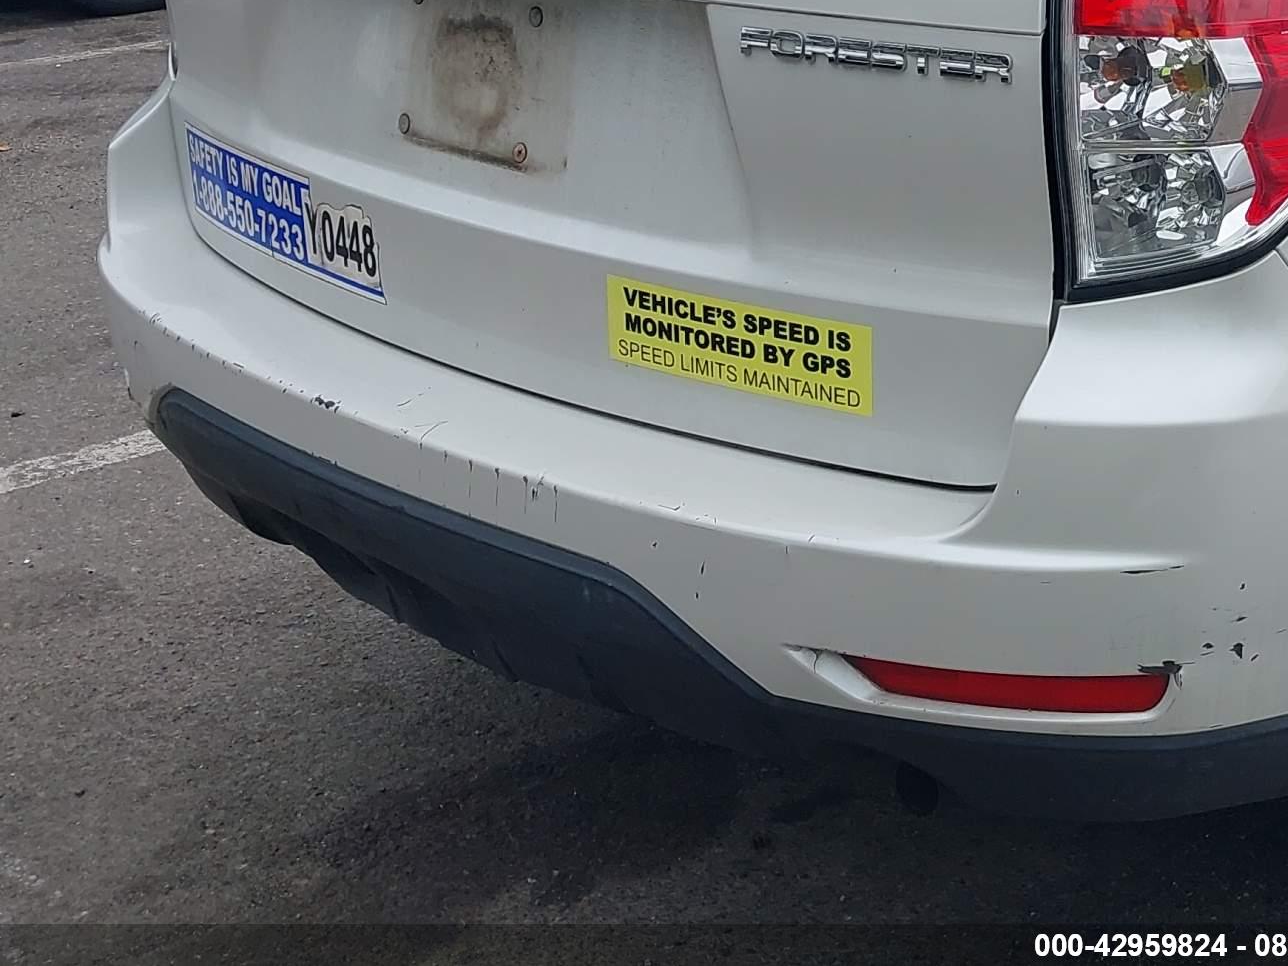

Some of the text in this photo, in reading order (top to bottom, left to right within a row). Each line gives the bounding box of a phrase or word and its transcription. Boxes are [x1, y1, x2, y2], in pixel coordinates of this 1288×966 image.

[740, 25, 1013, 84] FORESTER
[189, 134, 302, 216] SAFETY IS MY GOAL
[193, 169, 305, 261] 1-888-550-7233
[623, 286, 852, 352] VEHICLE'S SPEED IS
[625, 313, 852, 379] MONITORED BY GPS
[618, 339, 861, 408] SPEED LIMITS MAINTAINED
